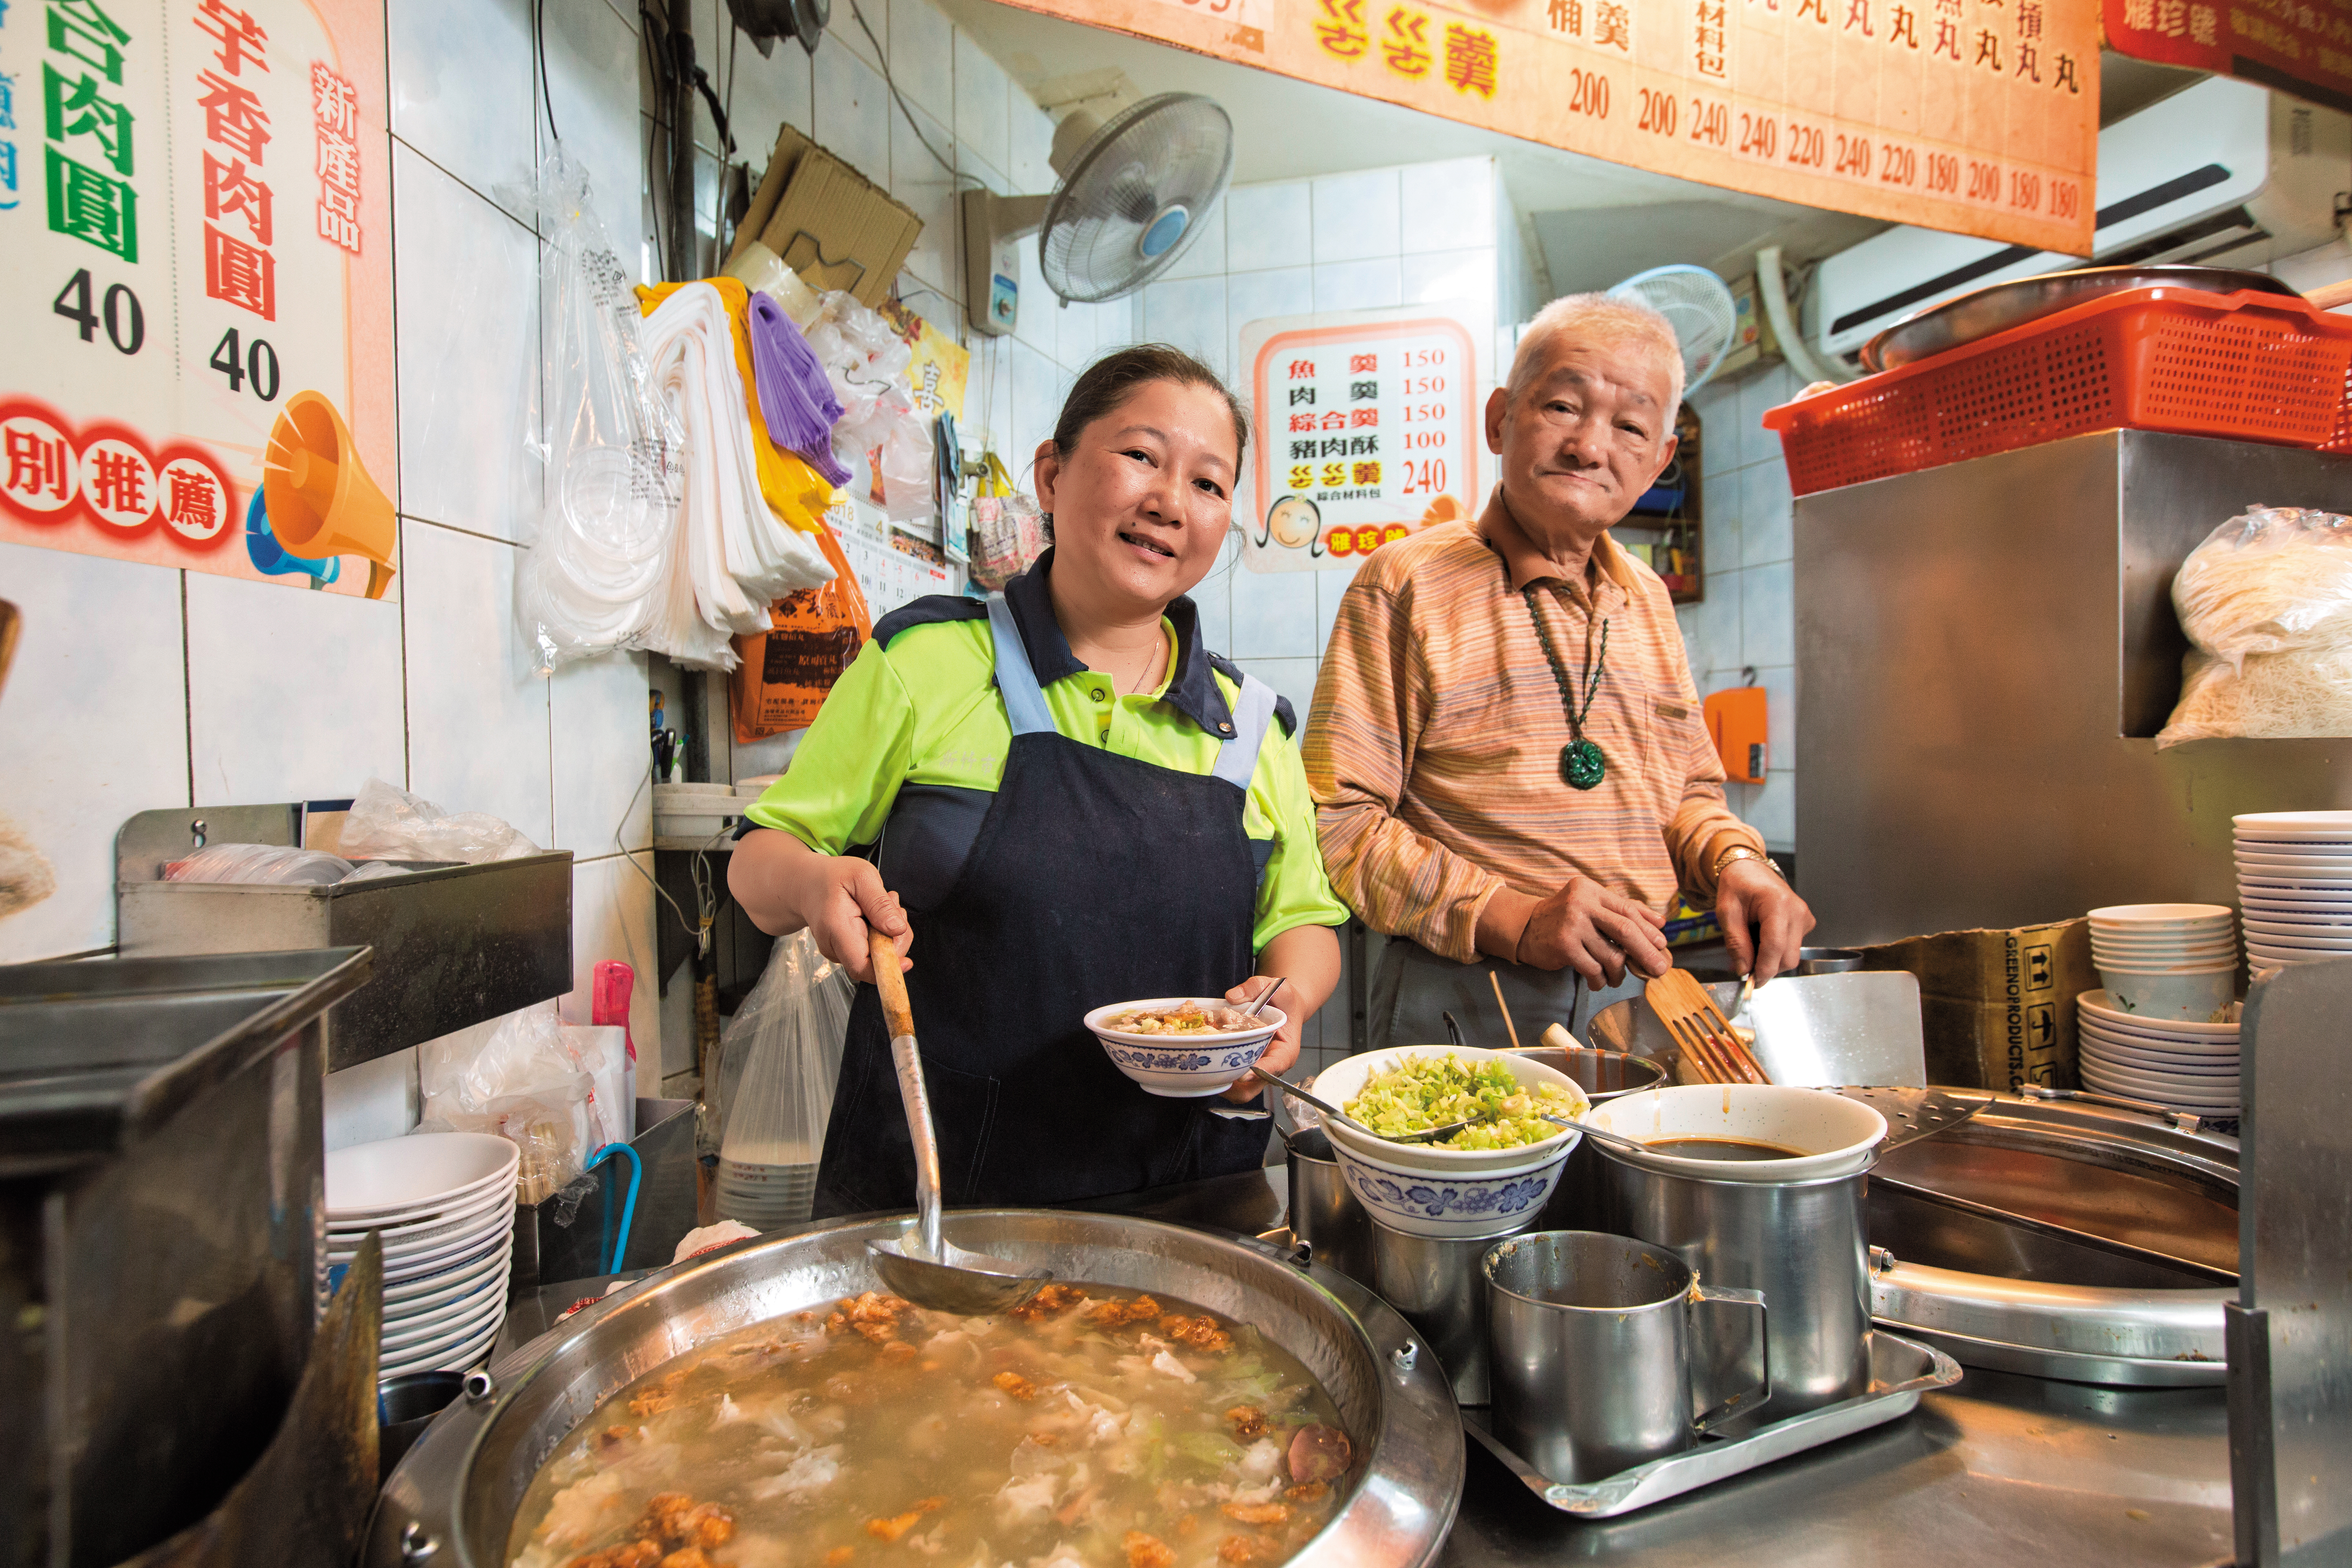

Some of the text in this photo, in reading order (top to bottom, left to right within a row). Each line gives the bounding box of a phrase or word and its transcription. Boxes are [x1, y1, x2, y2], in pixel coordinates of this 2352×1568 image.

[1890, 4, 1918, 49] 丸
[2054, 53, 2078, 94] 丸
[1569, 68, 1610, 119] 200
[1638, 87, 1677, 137] 200
[1691, 98, 1728, 146] 240
[1739, 113, 1776, 158] 240
[313, 66, 360, 252] 新產品
[1788, 124, 1824, 168] 220
[1835, 134, 1871, 177] 240
[1881, 144, 1916, 186] 220
[1926, 152, 1959, 194] 180
[1968, 162, 2000, 202] 200
[2010, 171, 2040, 211] 180
[2049, 180, 2078, 219] 180
[53, 268, 144, 355] 40
[210, 327, 280, 401] 40
[1403, 349, 1445, 368] 150
[1403, 376, 1445, 394] 150
[1403, 403, 1446, 422] 150
[1290, 430, 1446, 459] 豬肉酥 100
[4, 426, 217, 530] 別推薦
[1316, 488, 1381, 501] 綜合材料包
[1403, 458, 1446, 494] 240
[875, 520, 883, 535] 4
[846, 543, 850, 553] 2
[864, 551, 868, 561] 3
[881, 559, 886, 568] 4
[862, 574, 869, 585] 10
[880, 582, 886, 592] 11
[898, 565, 903, 575] 5
[915, 572, 920, 581] 6
[897, 587, 904, 598] 12
